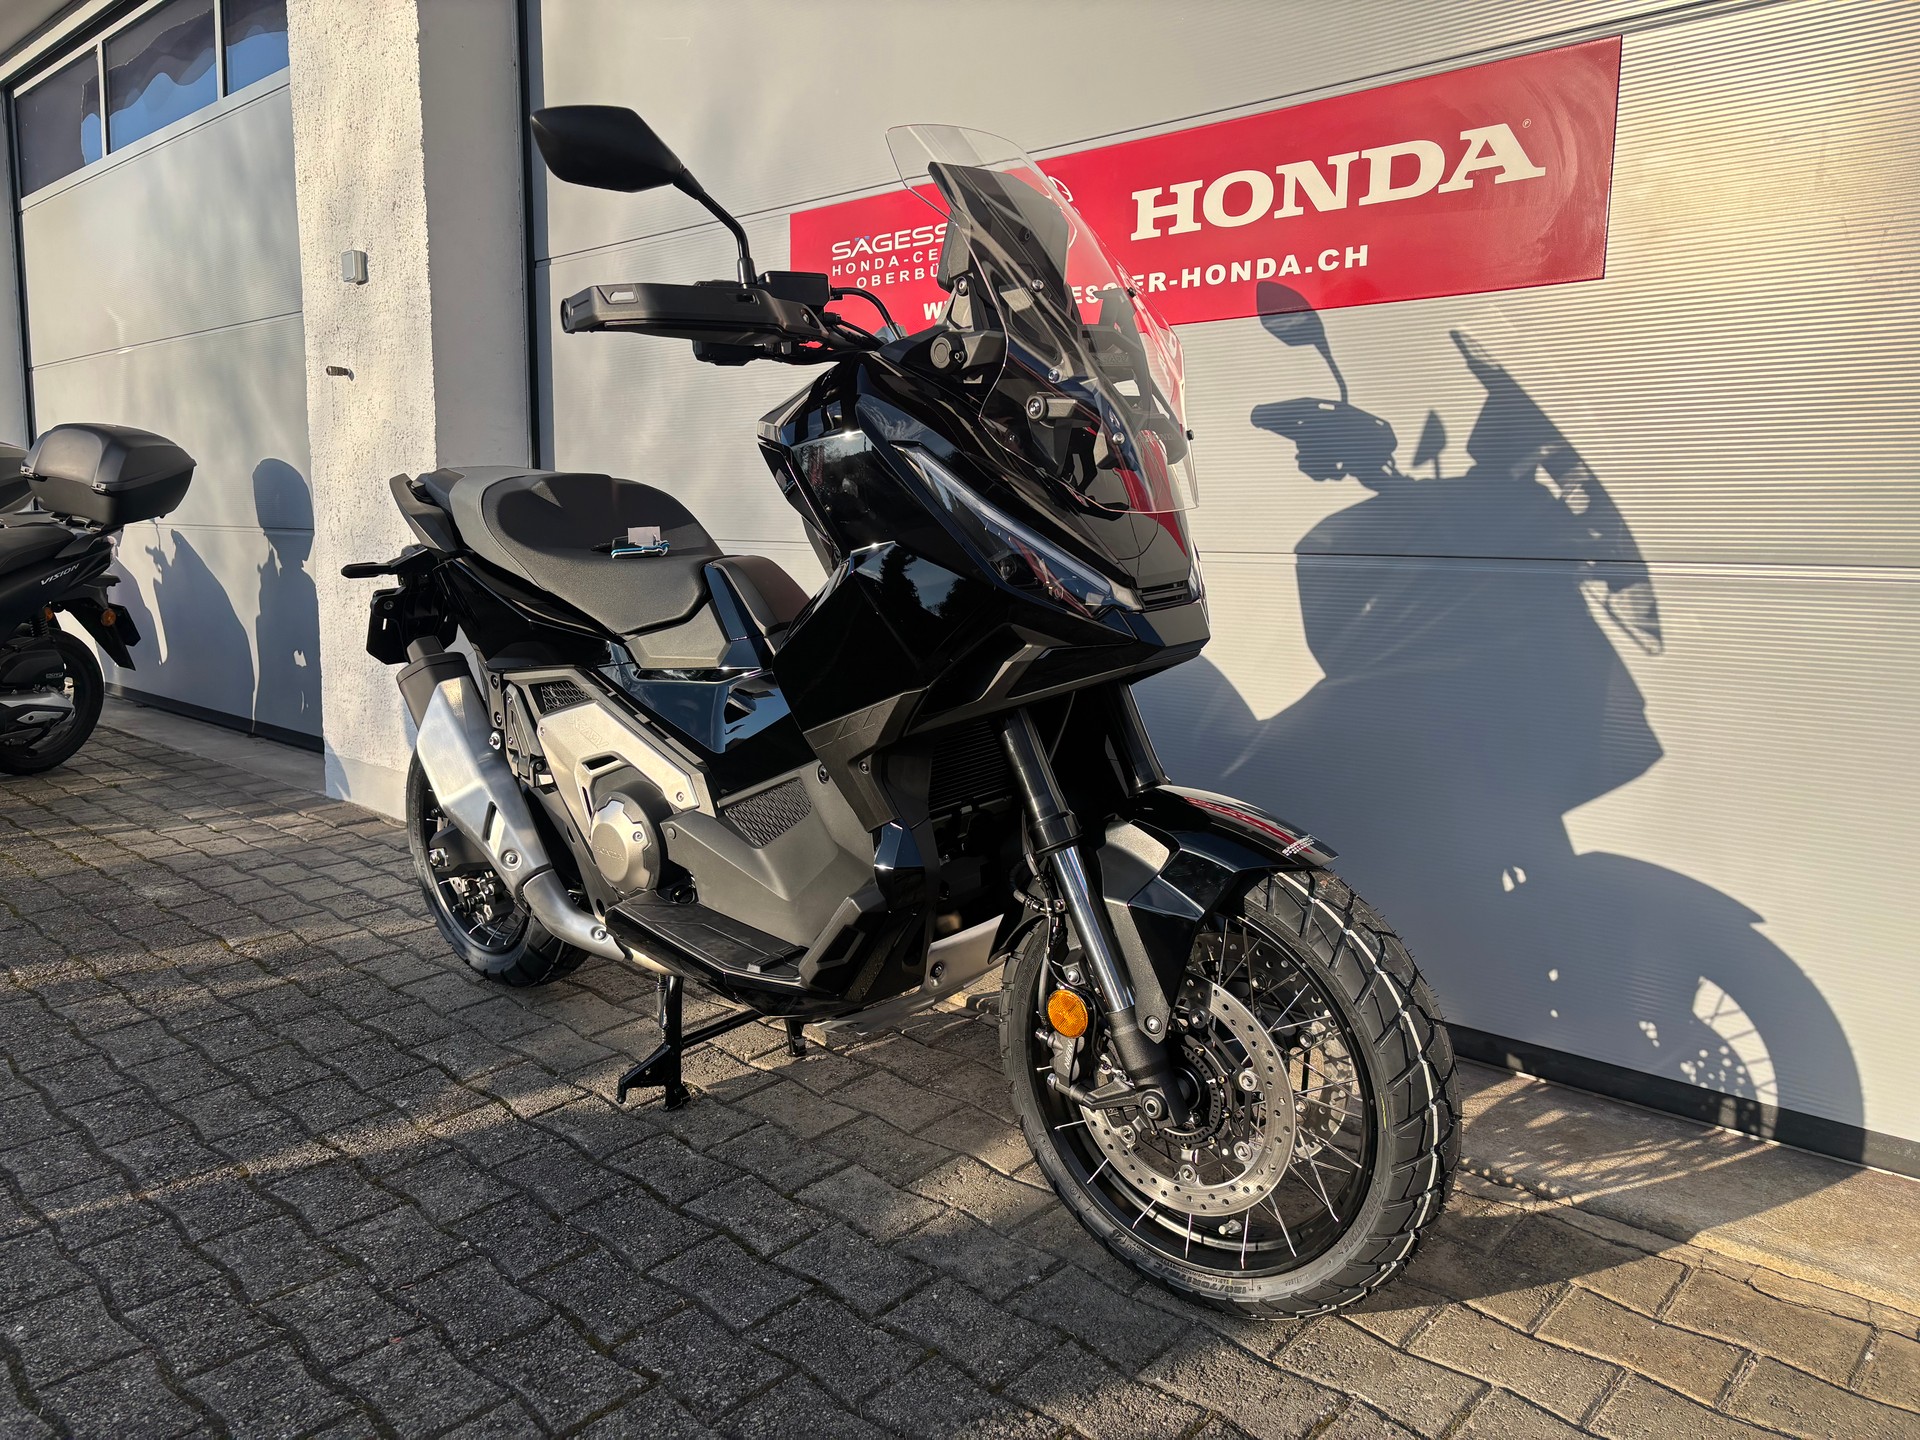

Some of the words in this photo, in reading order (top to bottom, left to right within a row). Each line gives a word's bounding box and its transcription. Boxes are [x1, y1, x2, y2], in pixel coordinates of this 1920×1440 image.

[1130, 123, 1546, 242] HONDA
[832, 222, 948, 261] SÄGESS
[832, 248, 939, 277] HONDA-CE
[856, 262, 939, 289] OBERBÜ
[40, 562, 80, 586] VISION
